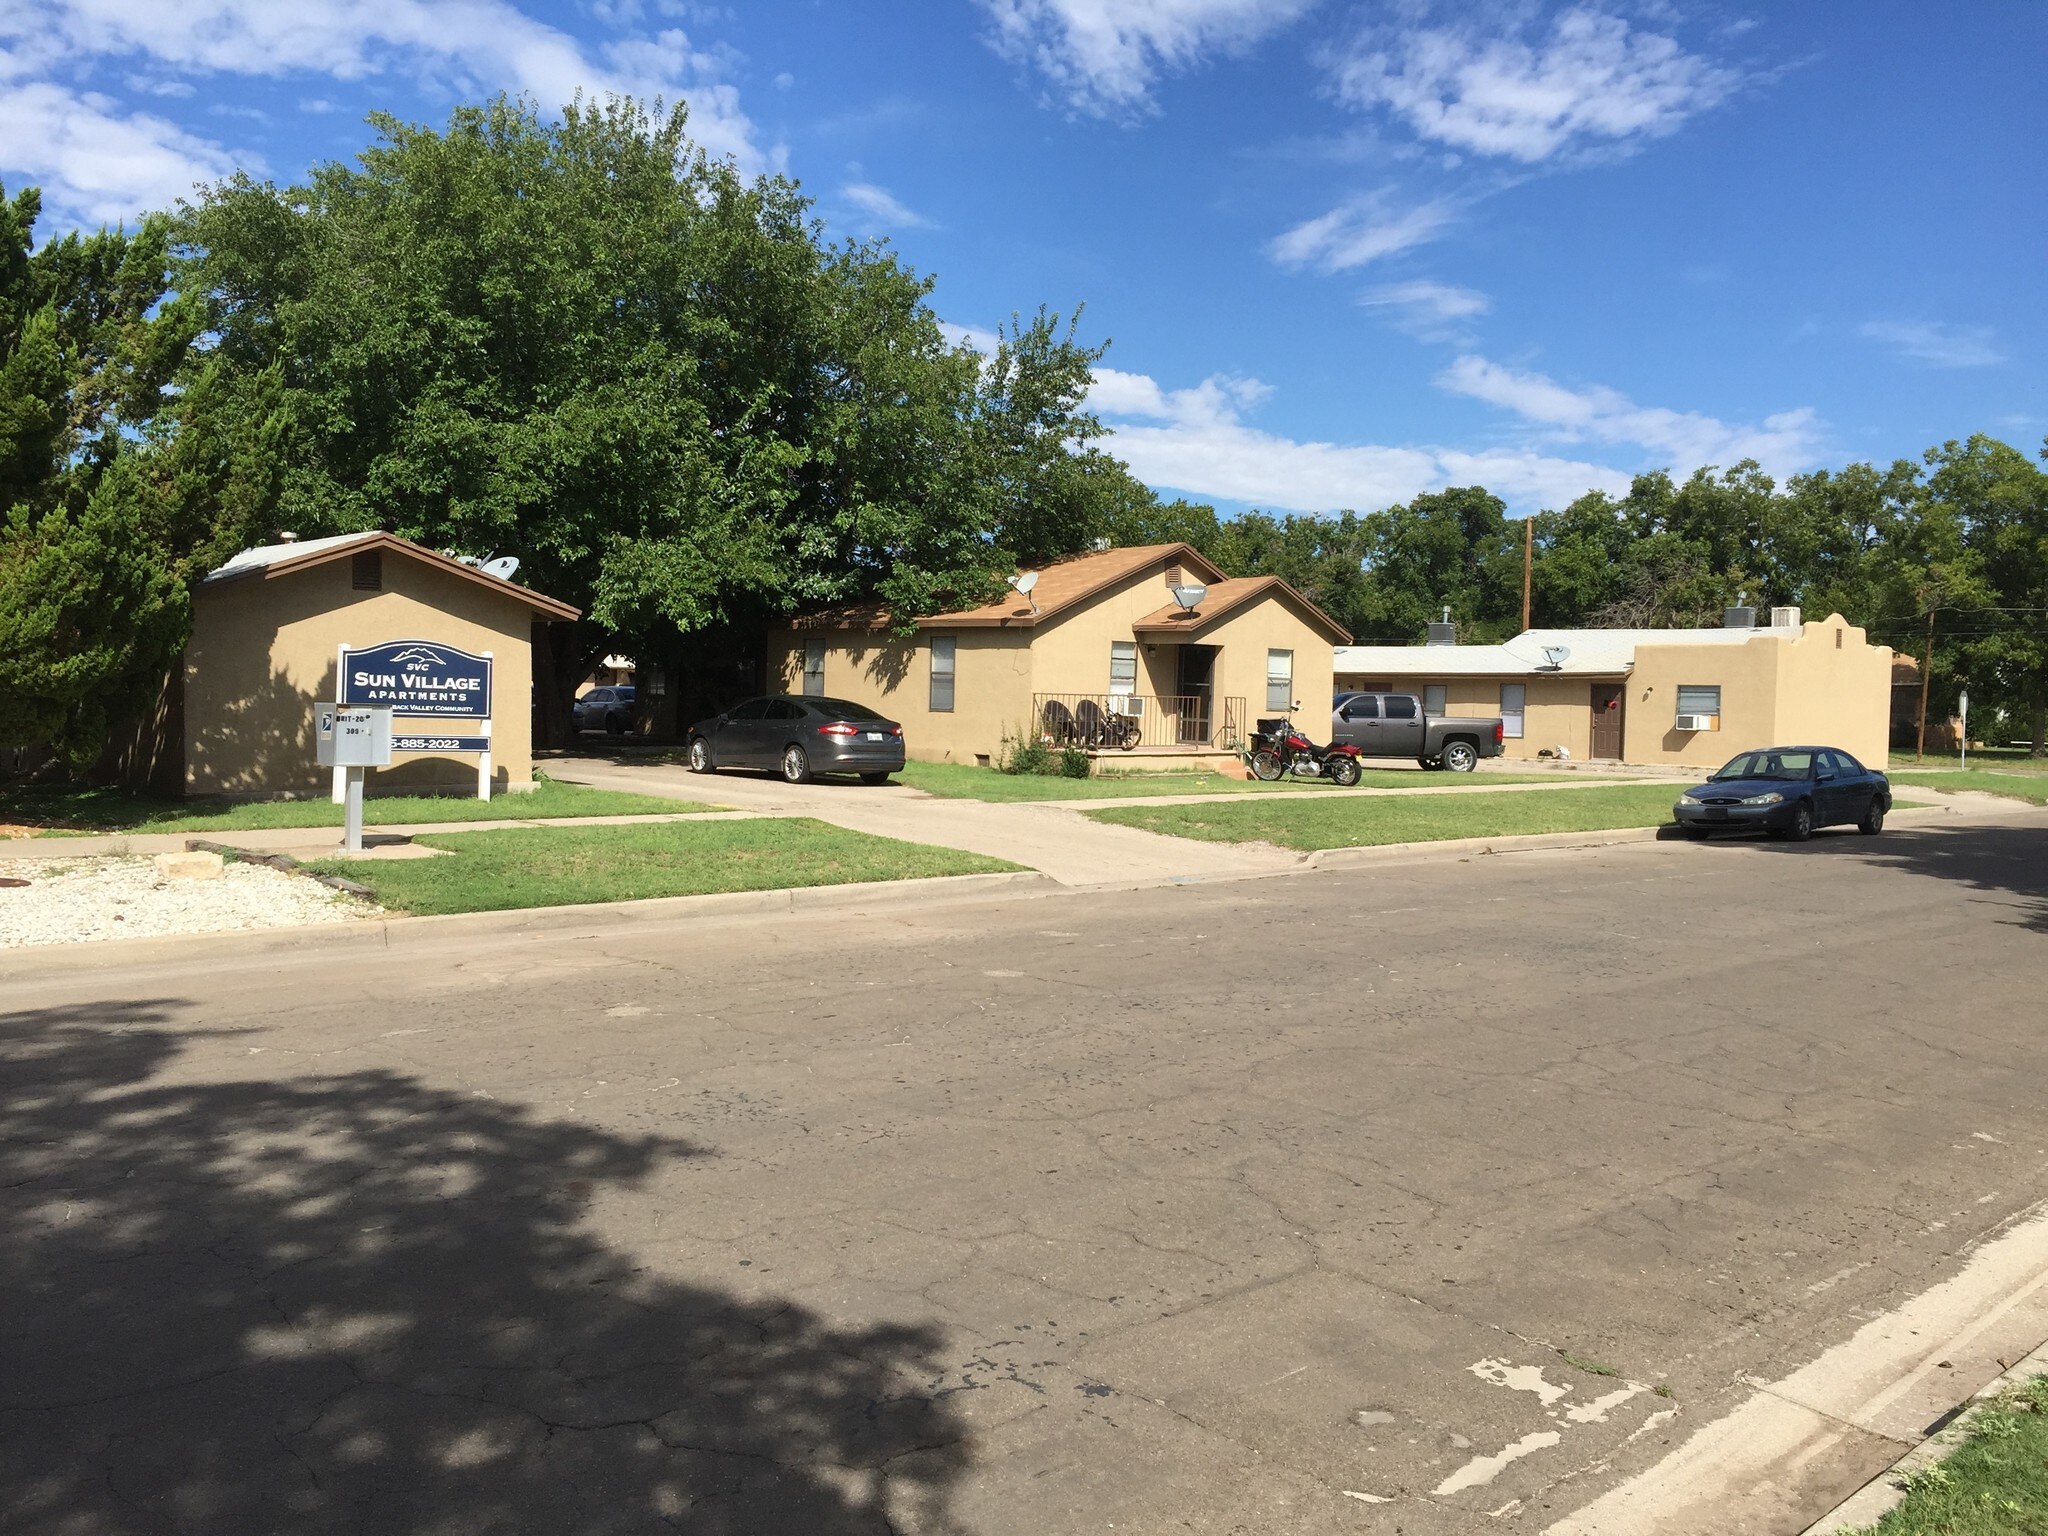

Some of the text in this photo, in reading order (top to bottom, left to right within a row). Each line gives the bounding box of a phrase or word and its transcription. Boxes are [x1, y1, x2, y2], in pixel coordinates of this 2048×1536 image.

[406, 663, 429, 671] SVC
[354, 672, 480, 690] SUN VILLAGE
[368, 691, 467, 702] APARTMENTS
[409, 704, 434, 712] VALLEY
